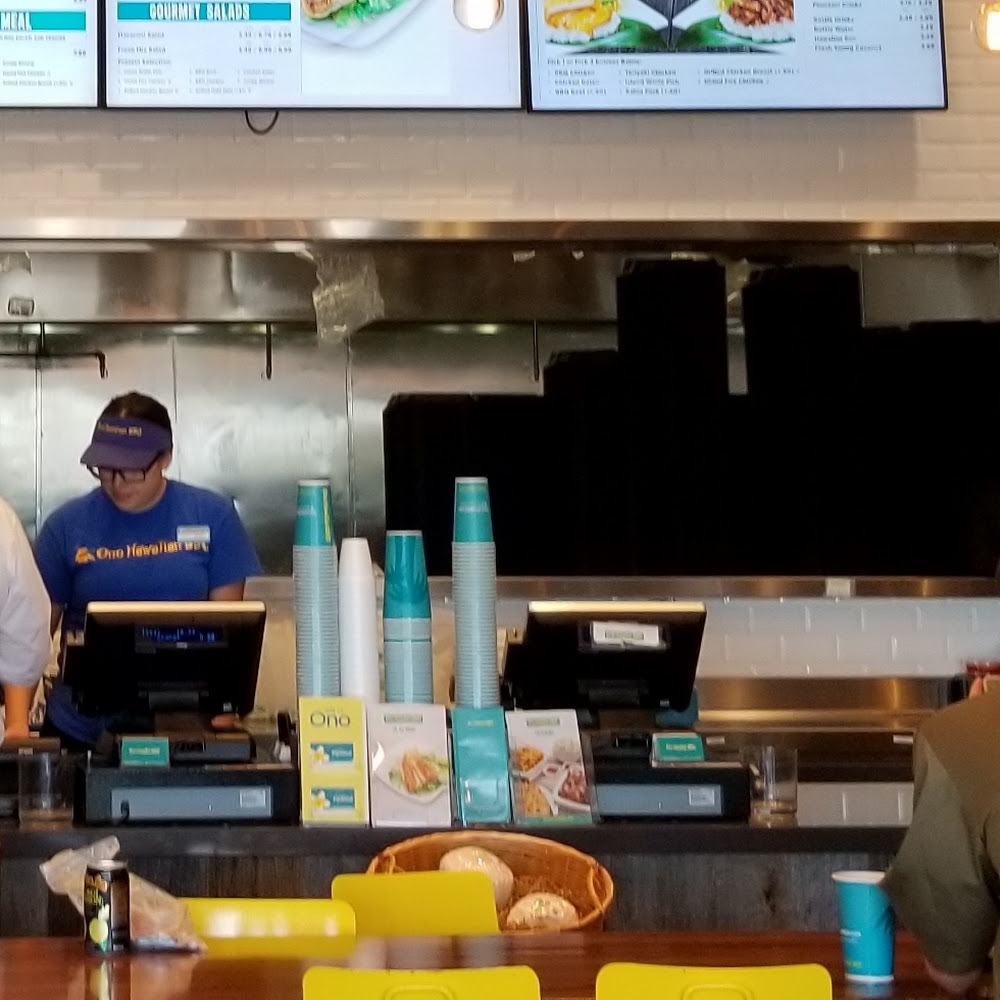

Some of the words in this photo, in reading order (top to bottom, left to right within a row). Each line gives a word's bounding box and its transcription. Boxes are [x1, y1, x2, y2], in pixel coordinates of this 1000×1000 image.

[149, 3, 200, 20] GOURMET
[206, 3, 250, 20] SALADS
[1, 11, 33, 30] MEAL
[96, 546, 124, 560] Ono
[310, 711, 351, 728] Ono
